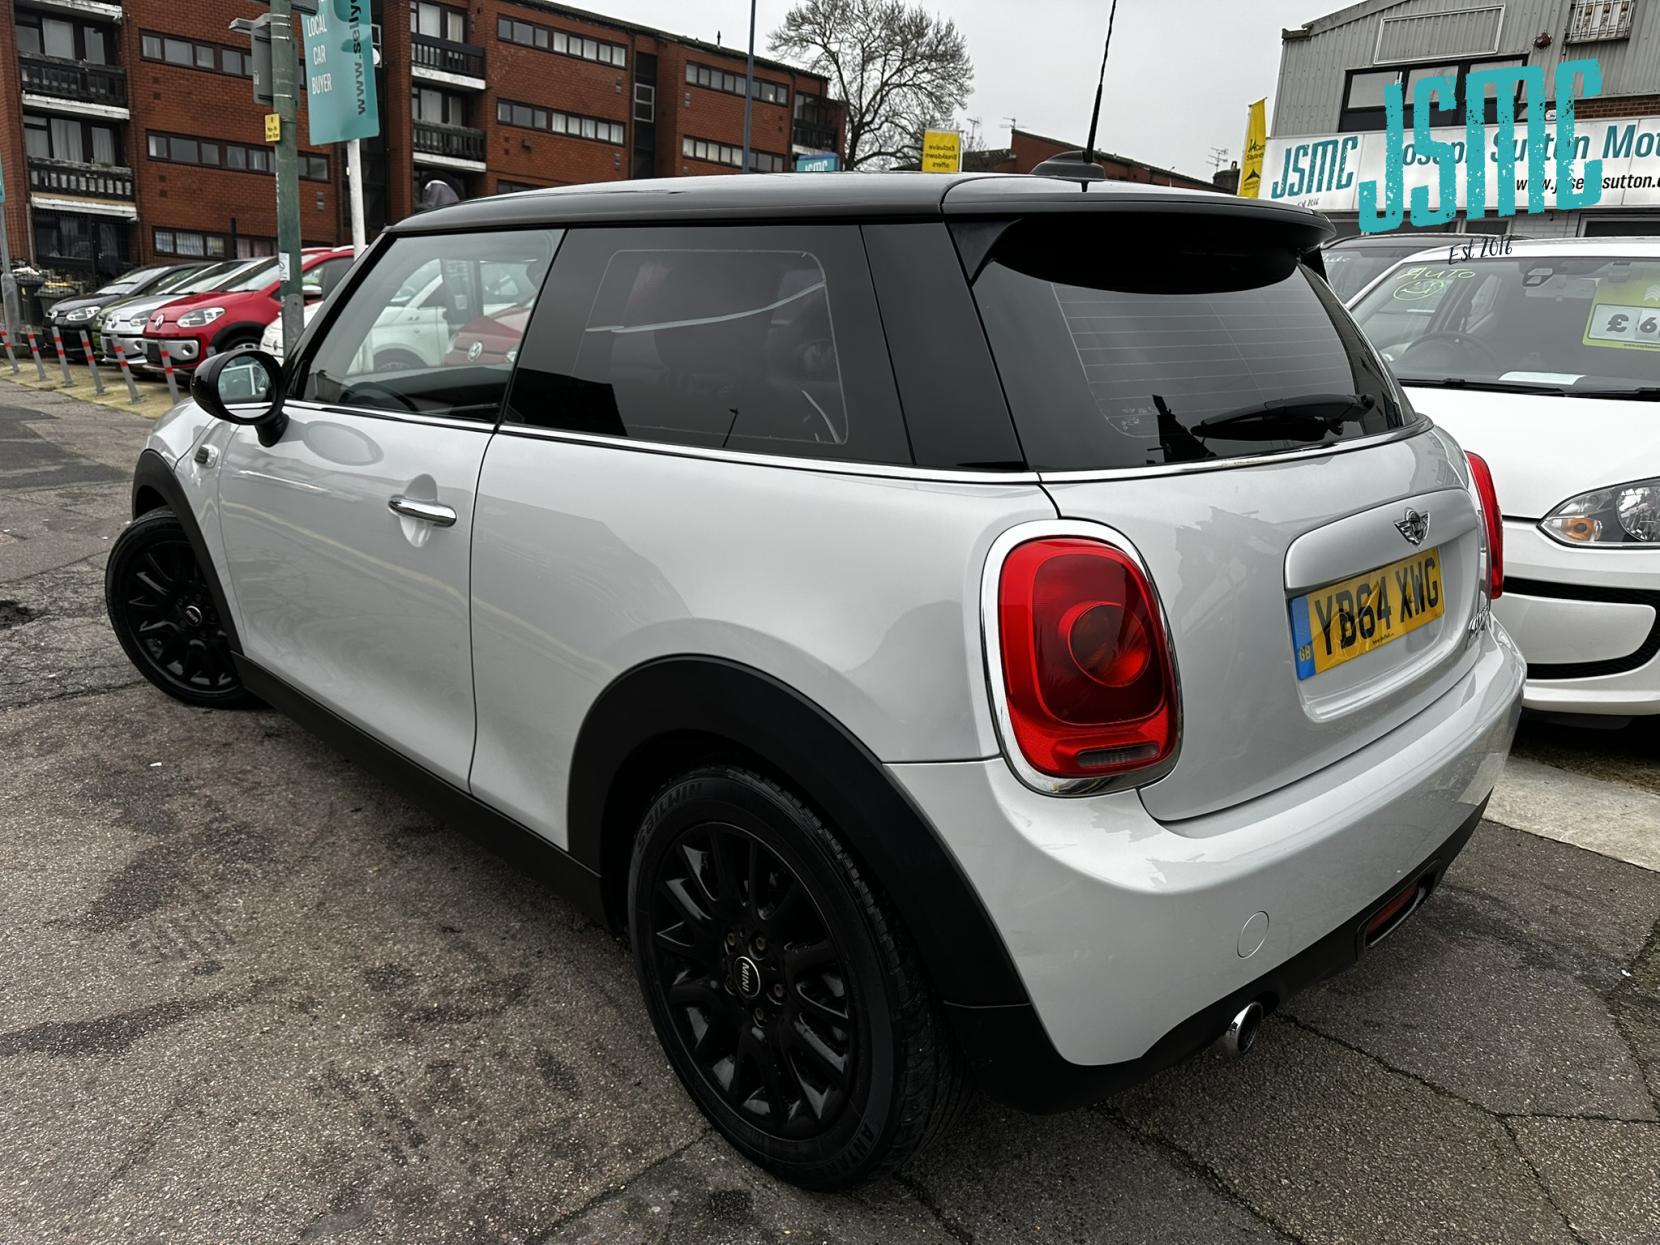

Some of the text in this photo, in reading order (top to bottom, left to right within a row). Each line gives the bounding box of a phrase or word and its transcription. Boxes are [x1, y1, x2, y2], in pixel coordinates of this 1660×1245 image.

[307, 15, 327, 37] LOCAL
[313, 45, 326, 65] CAR
[349, 0, 366, 116] www.selly
[312, 73, 332, 94] BUYER
[1270, 135, 1359, 200] JSMC
[1315, 556, 1439, 655] YD64 XWG
[741, 962, 751, 992] MINI
